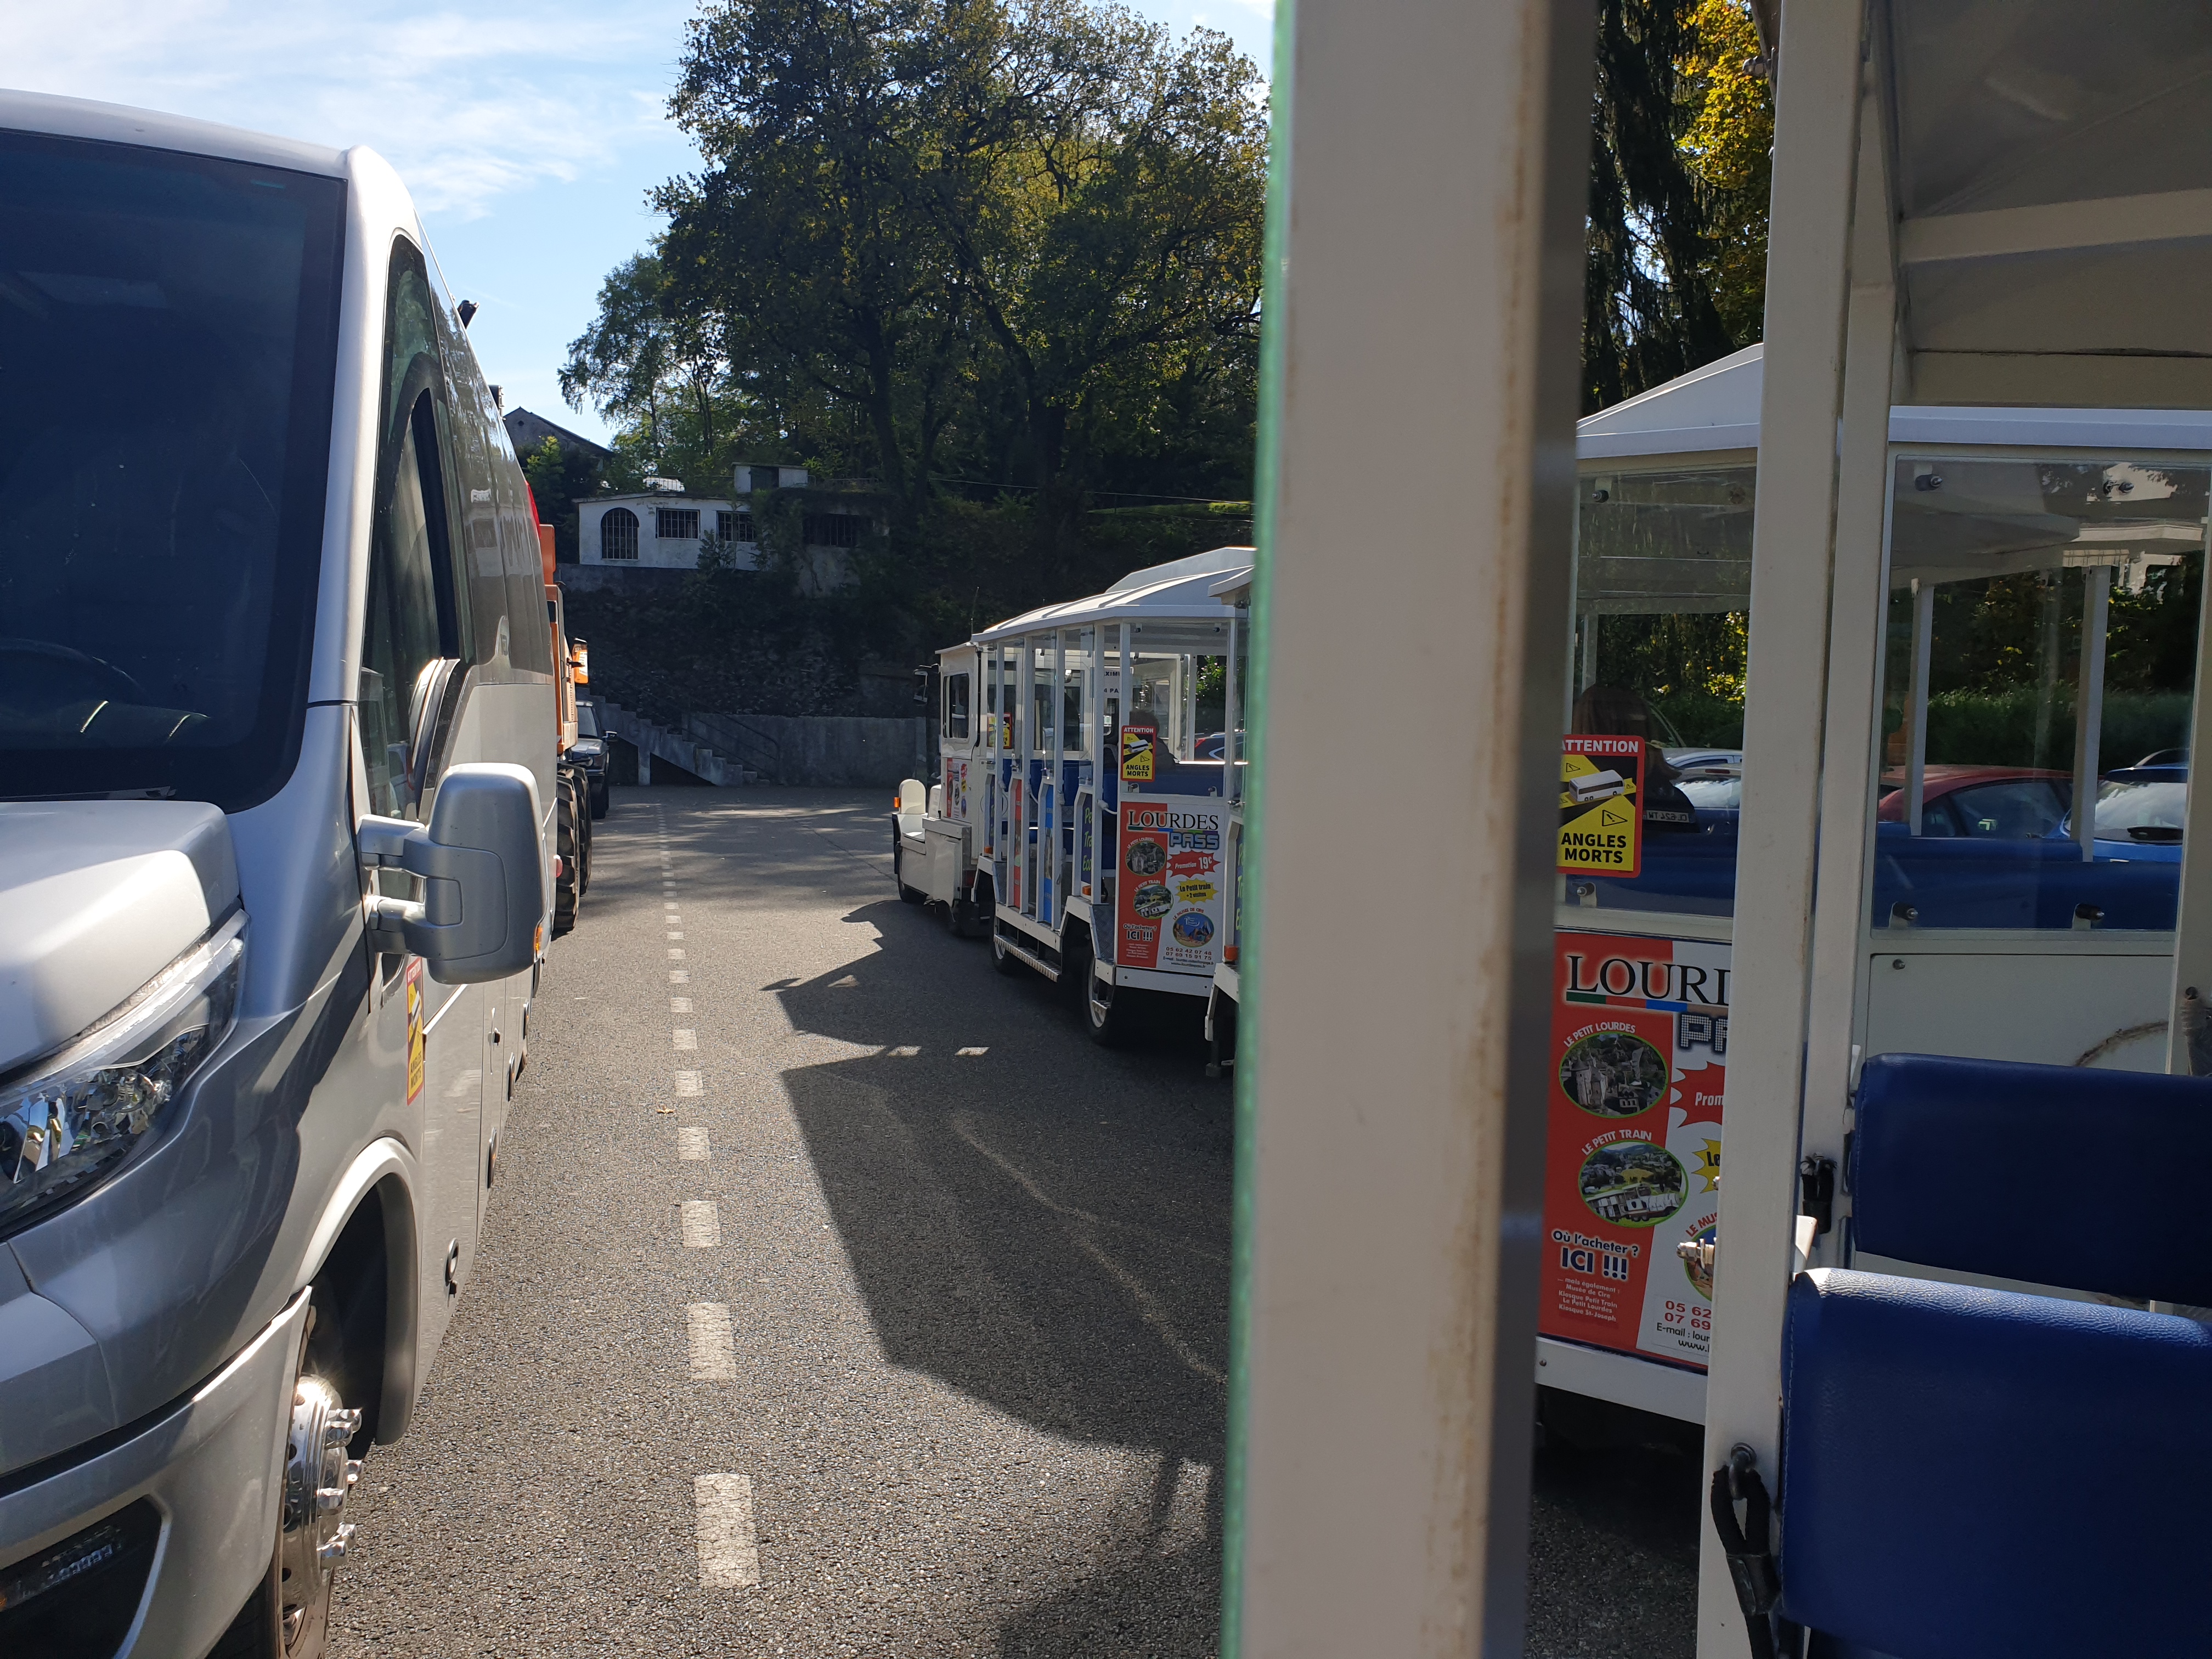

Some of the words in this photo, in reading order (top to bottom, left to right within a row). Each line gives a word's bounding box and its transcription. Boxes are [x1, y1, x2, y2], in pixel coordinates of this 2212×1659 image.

[1128, 811, 1218, 830] LOURDES
[1170, 832, 1219, 849] PASS
[1561, 833, 1627, 848] ANGLES
[1565, 848, 1623, 864] MORTS
[1127, 930, 1140, 940] ICI
[1564, 1037, 1575, 1047] LE
[1572, 1024, 1593, 1040] PETIT
[1595, 1022, 1636, 1034] LOURDES
[1581, 1143, 1594, 1155] LE
[1592, 1131, 1616, 1148] PETIT
[1619, 1129, 1652, 1141] TRAIN
[1685, 1224, 1698, 1237] LE
[1553, 1231, 1570, 1243] Où
[1632, 1245, 1639, 1256] ?
[1562, 1248, 1593, 1273] ICI
[1604, 1255, 1627, 1280] !!!
[1566, 1284, 1586, 1294] Musée
[1598, 1291, 1611, 1299] Cire
[1582, 1281, 1616, 1293] également
[1559, 1290, 1583, 1301] Kiosque
[1585, 1296, 1599, 1304] Petit
[1601, 1299, 1617, 1308] Train
[1572, 1299, 1586, 1307] Petit
[1587, 1303, 1612, 1313] Lourdes
[1559, 1304, 1583, 1314] Kiosque
[1666, 1300, 1685, 1312] 05
[1691, 1306, 1712, 1319] 62
[1664, 1312, 1685, 1324] 07
[1691, 1318, 1711, 1330] 69
[1657, 1322, 1685, 1337] E-mail
